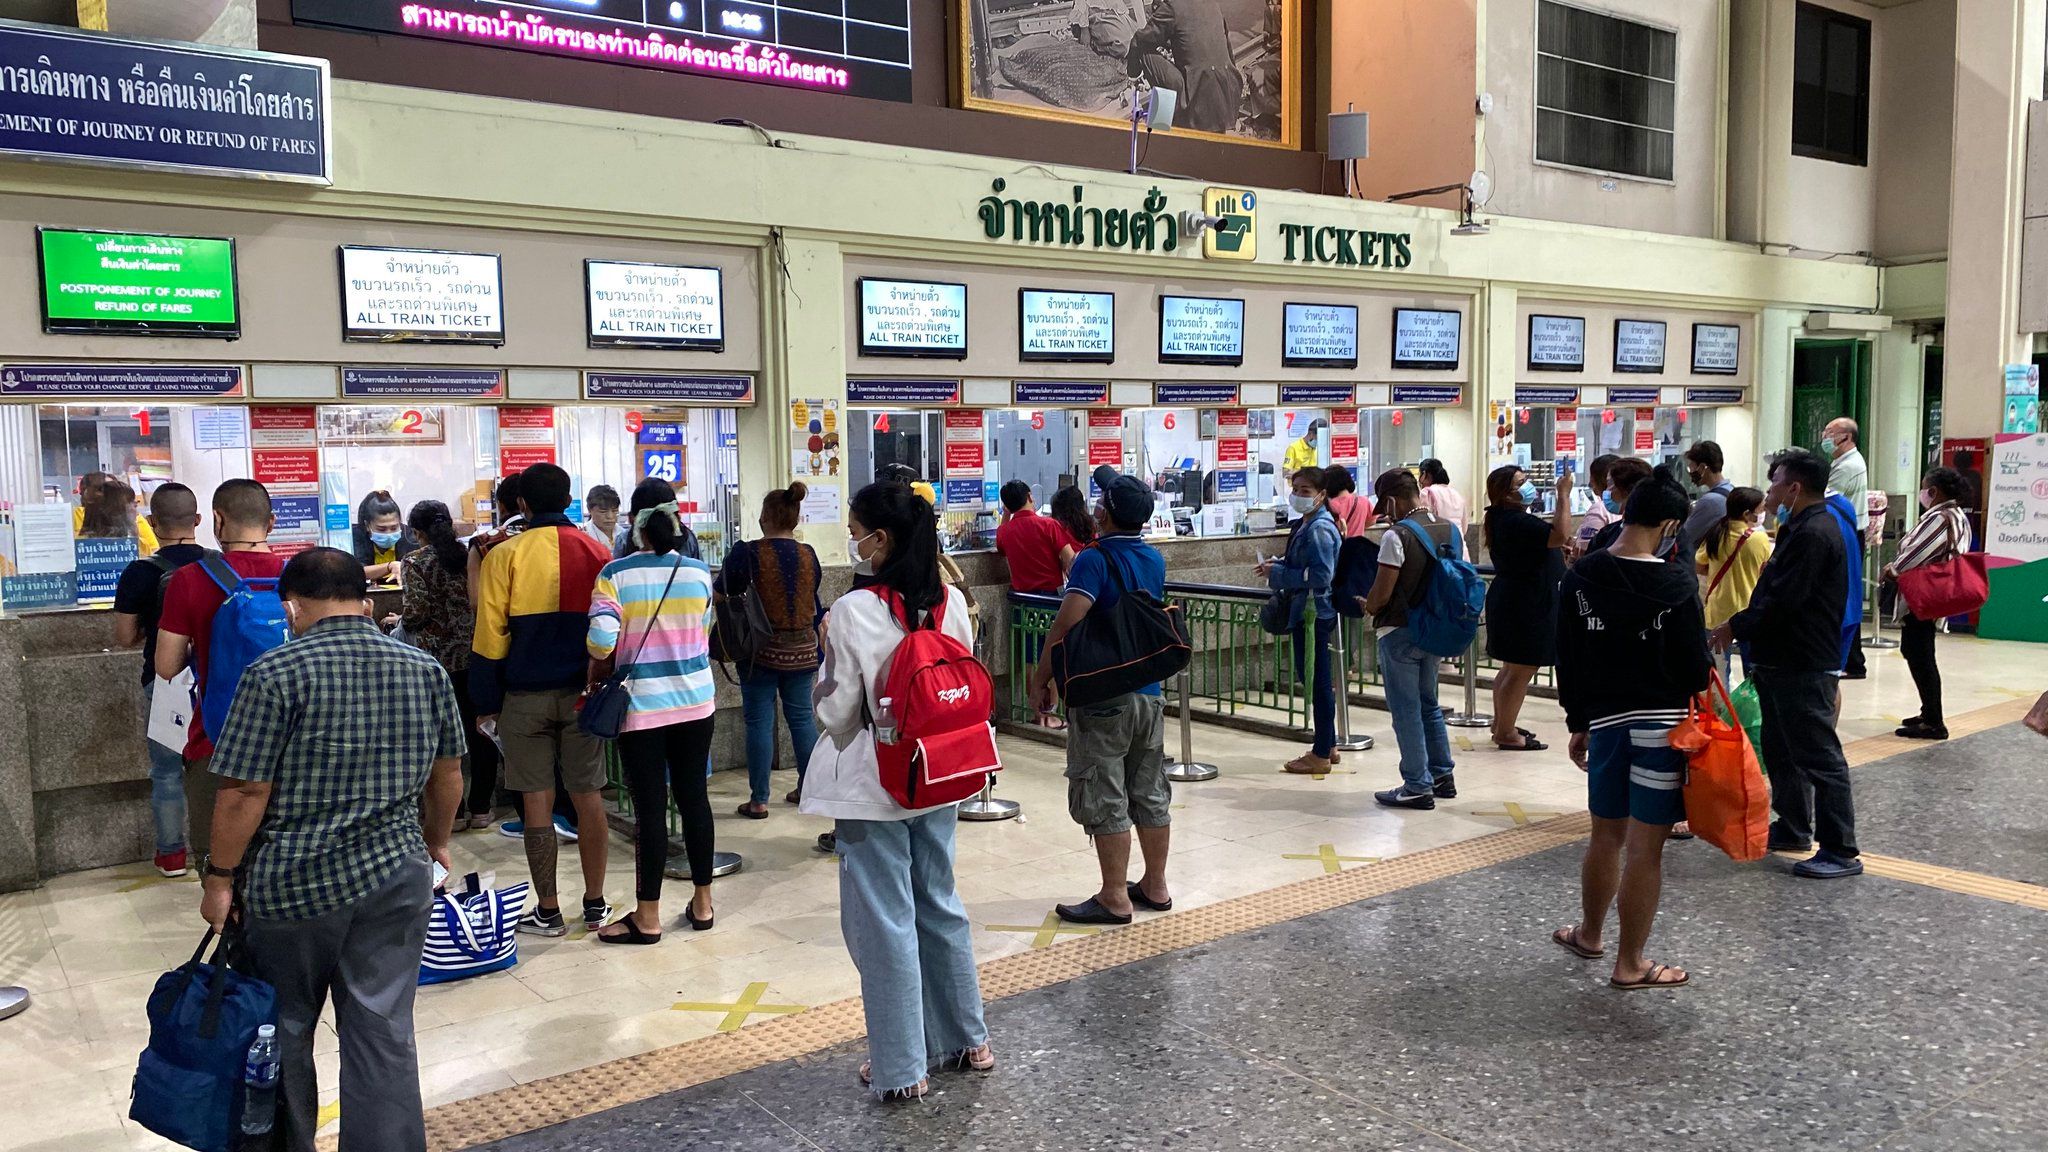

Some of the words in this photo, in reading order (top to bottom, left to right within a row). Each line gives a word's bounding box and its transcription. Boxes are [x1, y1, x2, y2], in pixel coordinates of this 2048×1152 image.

[118, 62, 315, 121] หรือคืนเงินค่าโดยสาร
[56, 118, 78, 136] OF
[81, 121, 155, 142] JOURNEY
[160, 126, 184, 144] OR
[186, 131, 246, 149] REFUND
[249, 135, 269, 151] OF
[272, 137, 316, 155] FARES
[978, 177, 1178, 252] จำหน่ายตั๋ว
[1279, 222, 1412, 269] TICKETS
[386, 256, 459, 276] จำหน่ายตั๋ว
[60, 283, 151, 296] POSTPONEMENT
[155, 286, 170, 297] OF
[173, 287, 222, 299] JOURNEY
[351, 277, 432, 293] ขบวนรถเร็ว
[447, 281, 492, 295] รถด่วน
[94, 301, 139, 312] REFUND
[142, 302, 157, 312] OF
[160, 303, 192, 314] FARES
[368, 296, 478, 313] และรถด่วนพิเศษ
[356, 312, 386, 324] ALL
[391, 312, 435, 325] TRAIN
[440, 314, 492, 327] TICKET
[599, 320, 624, 331] ALL
[628, 321, 666, 333] TRAIN
[670, 322, 713, 334] TICKET
[869, 332, 889, 342] ALL
[892, 332, 921, 343] TRAIN
[925, 333, 959, 344] TICKET
[1028, 338, 1046, 348] ALL
[1048, 339, 1075, 348] TRAIN
[1077, 339, 1108, 349] TICKET
[1166, 341, 1182, 351] ALL
[1184, 342, 1207, 351] TRAIN
[1209, 343, 1238, 352] TICKET
[1289, 346, 1304, 355] ALL
[1305, 346, 1326, 355] TRAIN
[1327, 347, 1353, 356] TICKET
[1399, 349, 1411, 358] ALL
[1413, 349, 1432, 358] TRAIN
[1433, 350, 1454, 359] TICKET
[1562, 353, 1580, 361] TICKET
[130, 410, 151, 436] 1
[402, 410, 423, 434] 2
[625, 411, 644, 433] 3
[873, 412, 890, 433] 4
[1031, 411, 1044, 430] 5
[1163, 412, 1176, 430] 6
[1283, 412, 1296, 429] 7
[648, 454, 677, 481] 25
